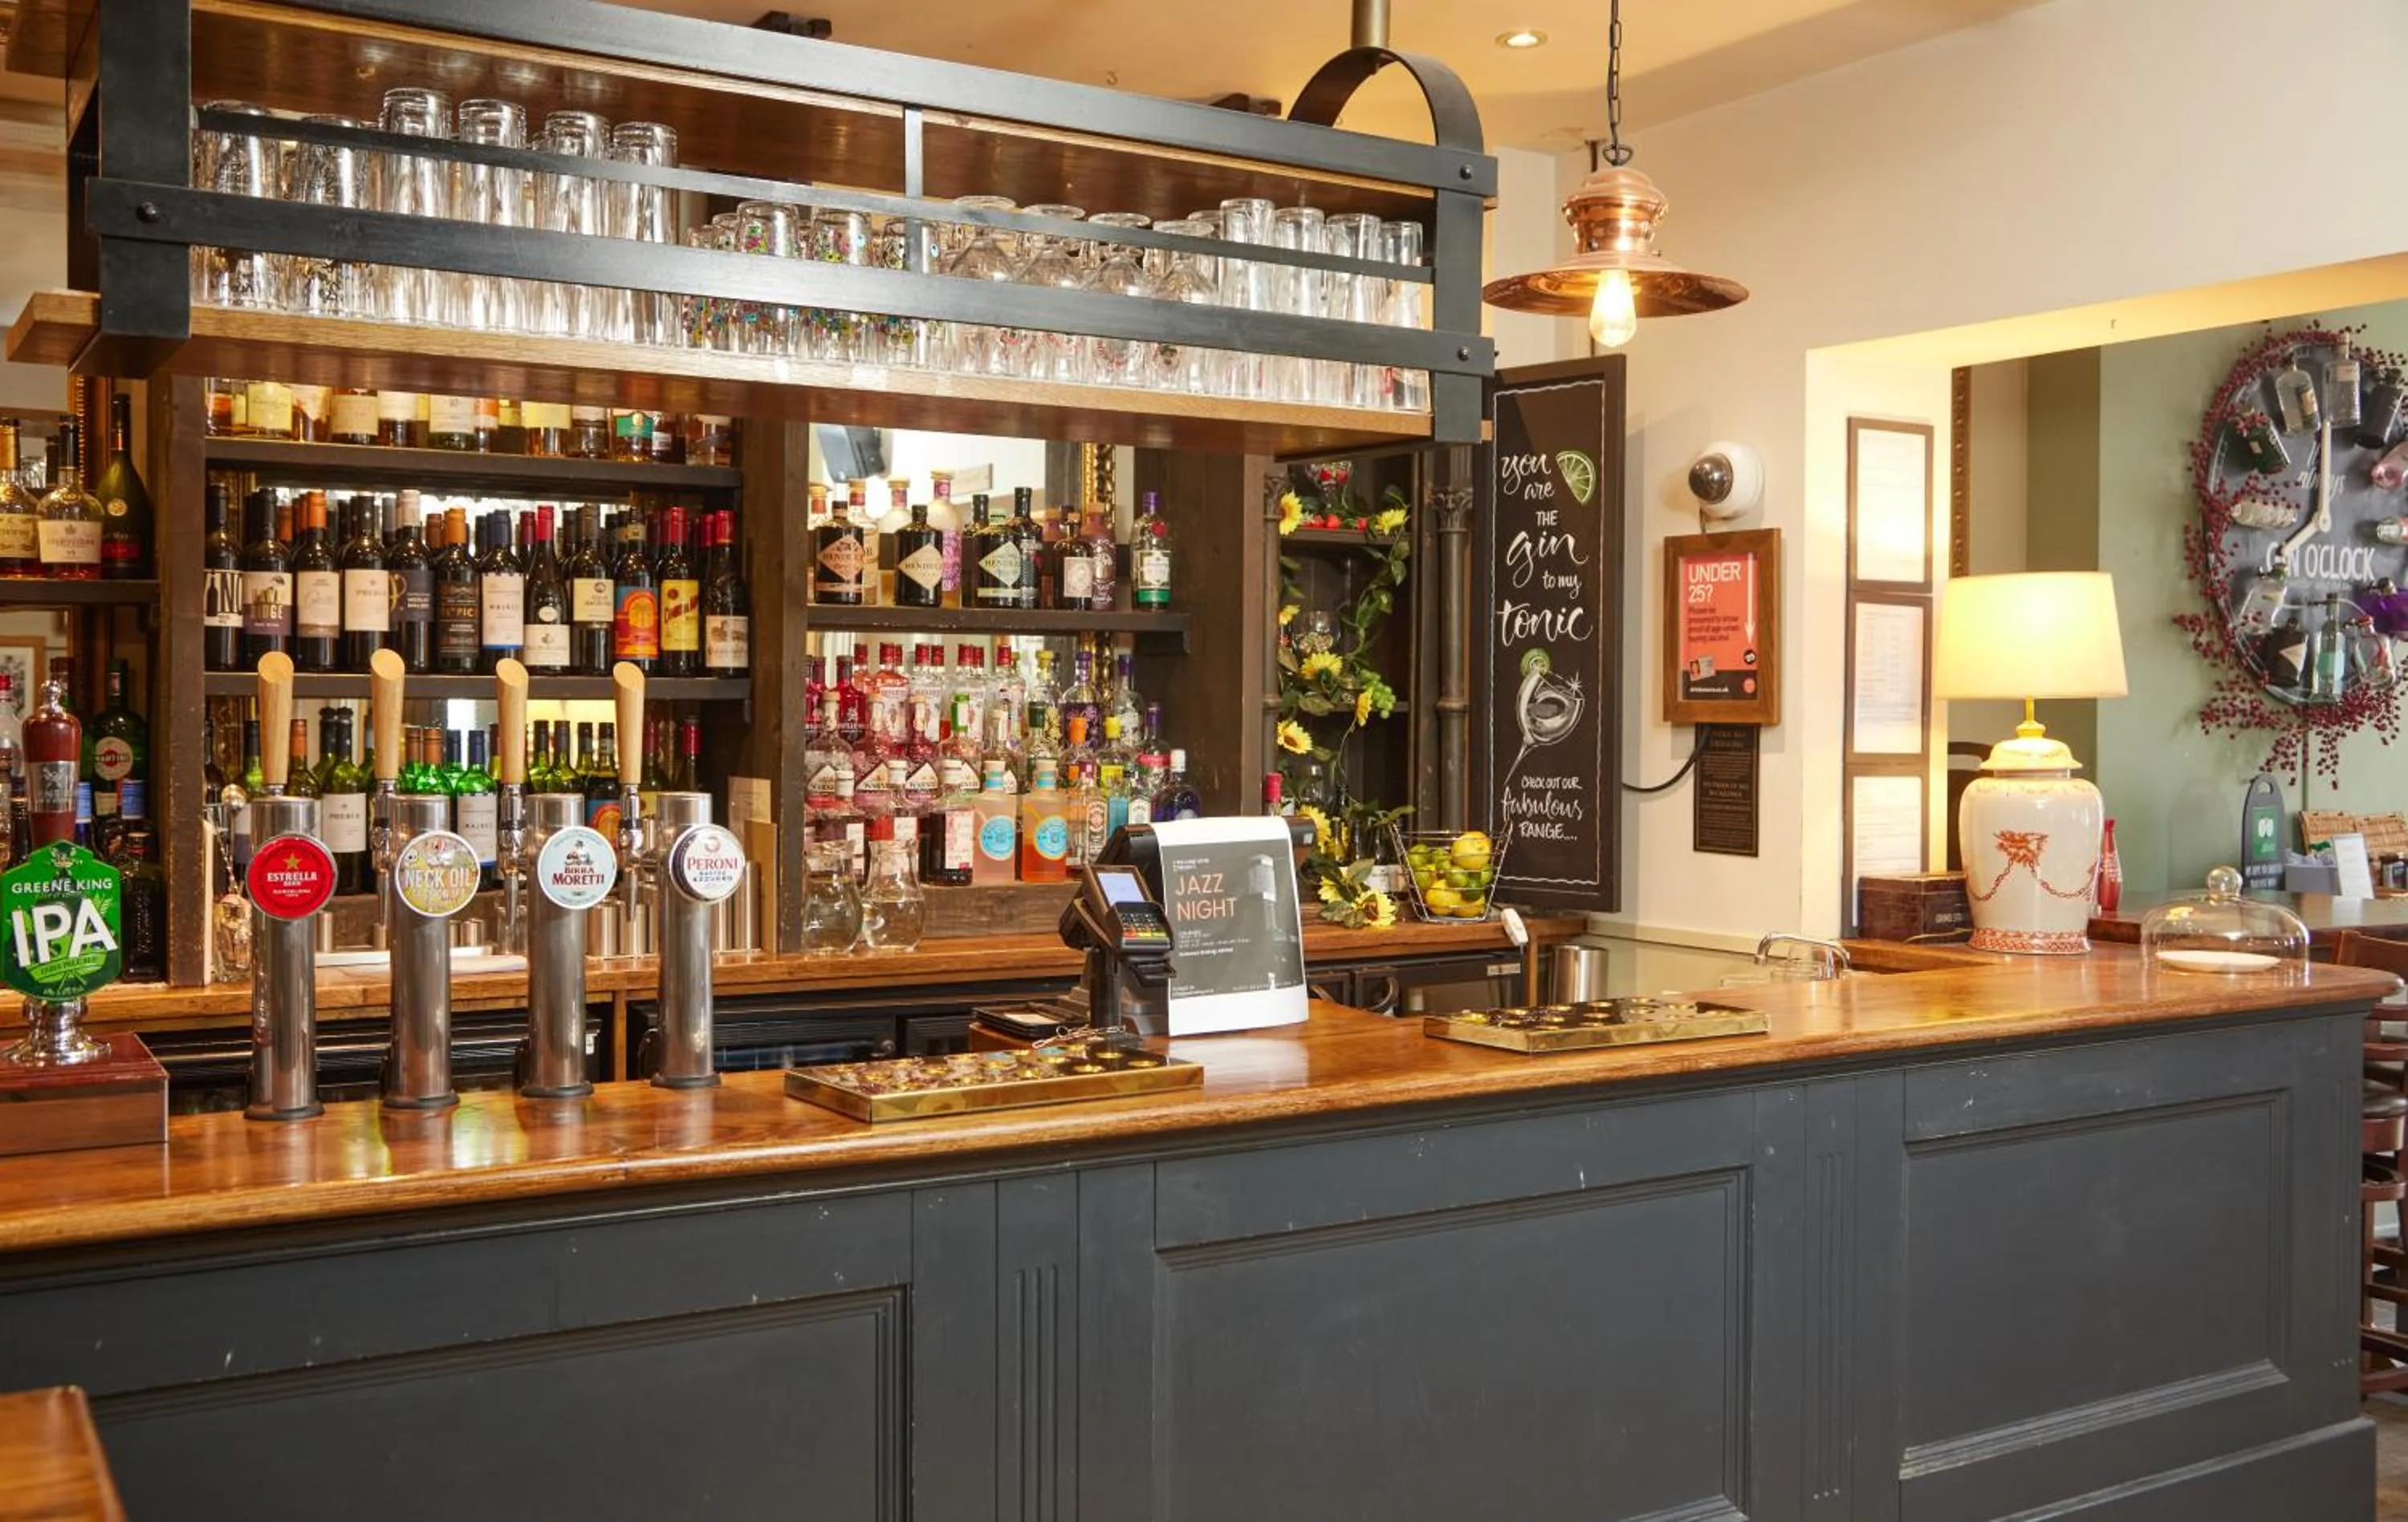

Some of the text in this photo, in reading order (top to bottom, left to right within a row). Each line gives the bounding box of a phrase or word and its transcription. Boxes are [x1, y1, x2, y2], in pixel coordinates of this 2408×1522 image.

[1501, 454, 1552, 495] you
[1524, 481, 1555, 500] are
[1536, 510, 1559, 527] THE
[1506, 531, 1590, 588] gin
[2304, 543, 2376, 582] O'CLOCK
[1542, 570, 1582, 600] to my
[1688, 562, 1741, 584] UNDER
[1495, 599, 1593, 647] tonic
[1500, 787, 1584, 821] fabulous
[688, 857, 738, 870] PERONI
[11, 878, 113, 894] GREENE KING
[267, 871, 318, 882] ESTRELLA
[405, 867, 472, 889] NECK OIL
[552, 873, 604, 885] MORETTI
[1174, 873, 1225, 897] JAZZ
[1177, 897, 1238, 922] NIGHT
[11, 897, 119, 970] IPA
